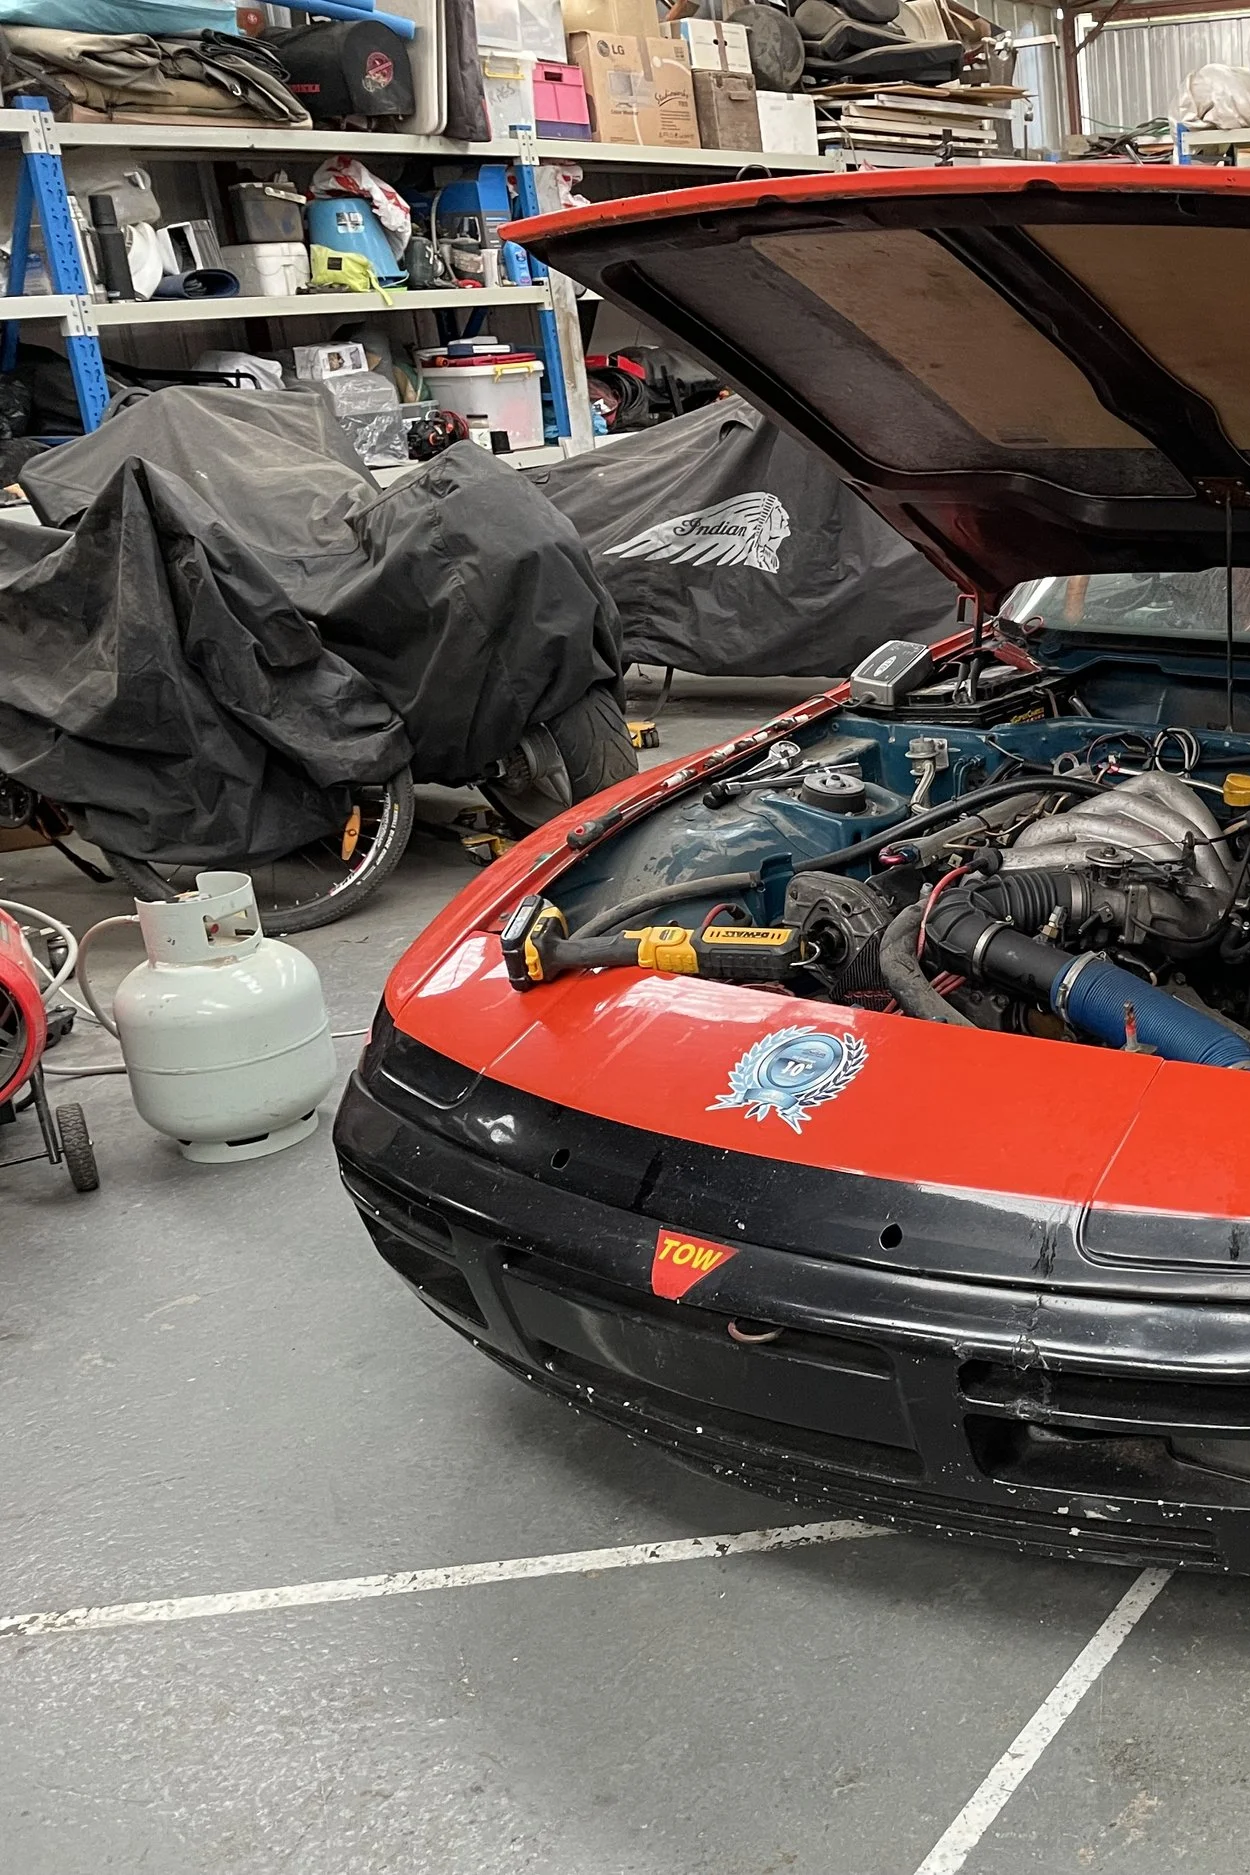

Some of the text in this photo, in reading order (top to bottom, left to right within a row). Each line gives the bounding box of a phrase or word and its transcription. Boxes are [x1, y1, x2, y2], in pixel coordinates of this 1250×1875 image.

[611, 44, 626, 56] LG
[672, 516, 748, 538] Indian
[657, 1237, 724, 1272] TOW
